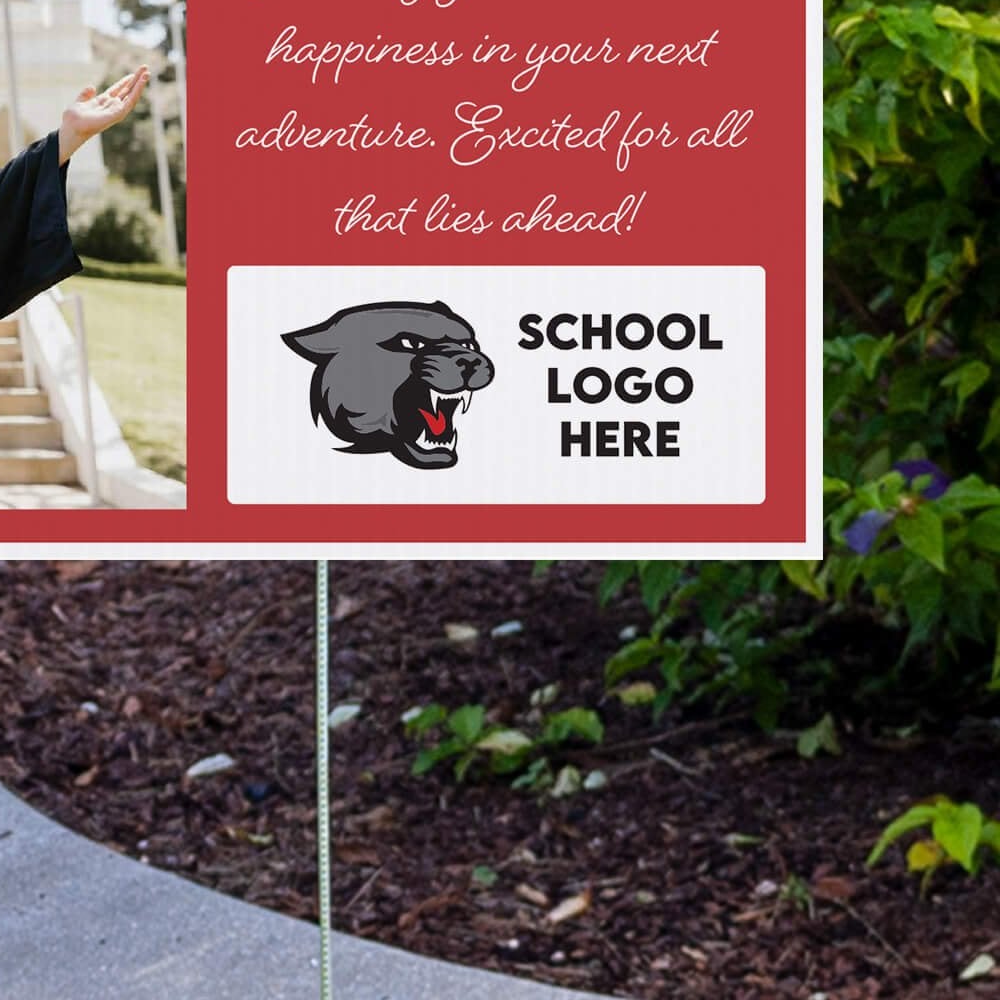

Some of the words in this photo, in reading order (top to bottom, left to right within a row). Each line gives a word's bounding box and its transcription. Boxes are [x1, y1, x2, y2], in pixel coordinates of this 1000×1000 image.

[265, 26, 463, 84] happiness
[472, 34, 516, 64] in
[511, 43, 620, 92] your
[628, 30, 720, 67] next
[235, 110, 436, 152] adventure.
[450, 101, 620, 167] Excited
[616, 110, 679, 172] for
[687, 109, 754, 148] all
[334, 194, 419, 236] that
[425, 194, 494, 236] lies
[502, 191, 647, 236] ahead!
[517, 313, 723, 351] SCHOOL
[547, 366, 695, 404] LOGO
[560, 420, 681, 458] HERE
